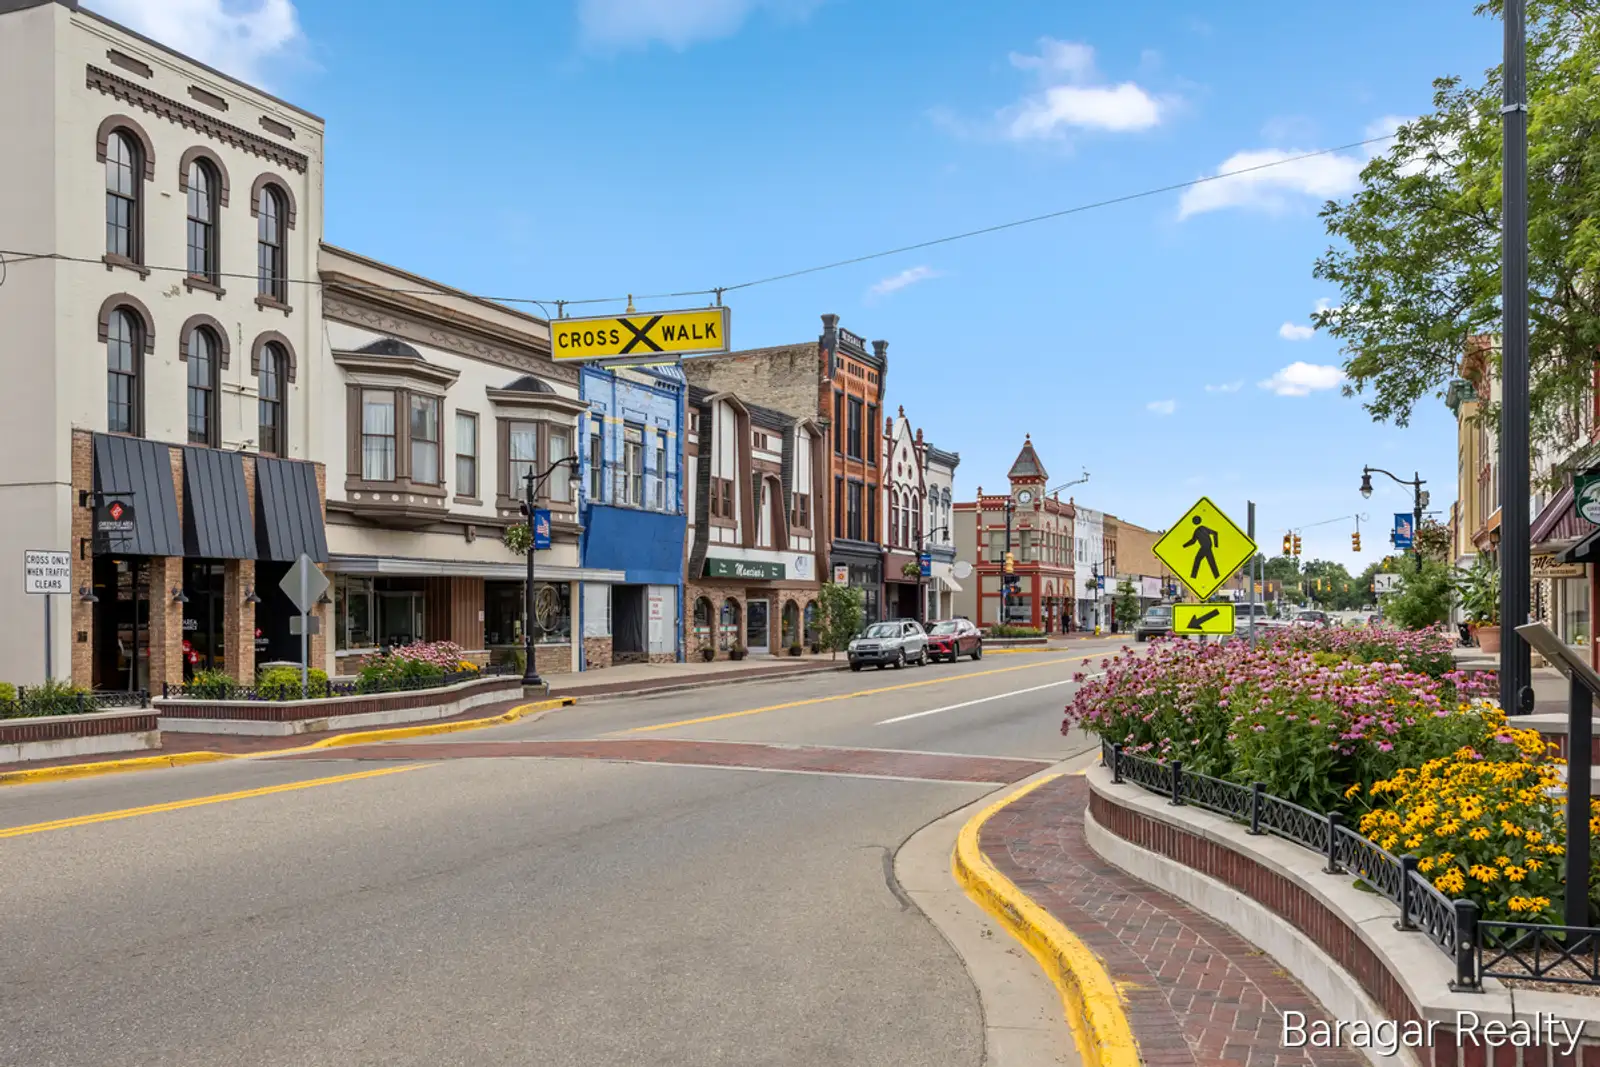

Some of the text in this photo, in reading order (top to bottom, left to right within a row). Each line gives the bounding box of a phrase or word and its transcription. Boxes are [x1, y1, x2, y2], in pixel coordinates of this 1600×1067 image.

[558, 329, 620, 348] CROSS
[661, 322, 717, 342] WALK
[26, 555, 69, 565] CROSS ONLY
[27, 568, 69, 577] WHEN TRAFFIC
[34, 580, 62, 589] CLEARS
